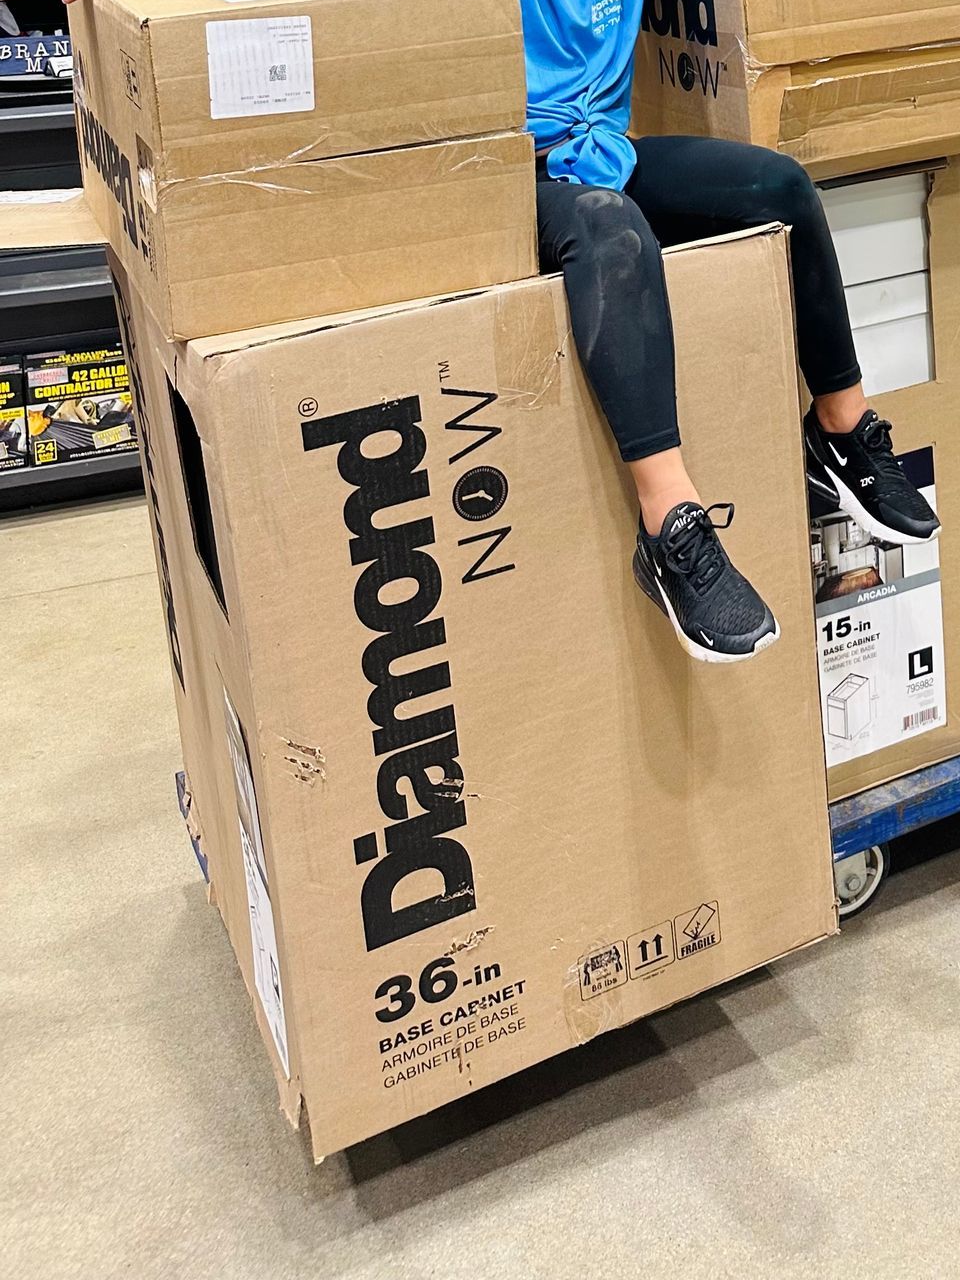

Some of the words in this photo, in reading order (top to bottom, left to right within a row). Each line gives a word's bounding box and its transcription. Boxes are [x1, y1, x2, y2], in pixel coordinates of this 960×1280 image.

[659, 47, 720, 99] NOW
[72, 370, 88, 381] 42
[35, 378, 113, 398] CONTRACTOR
[37, 442, 55, 453] 24
[440, 387, 516, 584] NOW
[857, 584, 897, 603] ARCADIA
[822, 615, 871, 642] 15-in
[823, 643, 844, 656] BASE
[846, 632, 881, 648] CABINET
[823, 652, 850, 664] ARMOIRE
[860, 645, 875, 655] BASE
[300, 395, 477, 952] Diamond
[824, 660, 852, 673] GABINETE
[862, 652, 878, 661] BASE
[913, 652, 929, 676] L
[906, 678, 934, 694] 795982
[680, 933, 716, 957] FRAGILE
[374, 957, 501, 1024] 36-in
[379, 1020, 434, 1054] BASE
[381, 1031, 453, 1072] ARMOIRE
[457, 1022, 476, 1039] DE
[480, 1003, 519, 1030] BASE
[383, 1045, 462, 1089] GABINETE
[464, 1035, 485, 1054] DE
[488, 1017, 527, 1046] BASE
